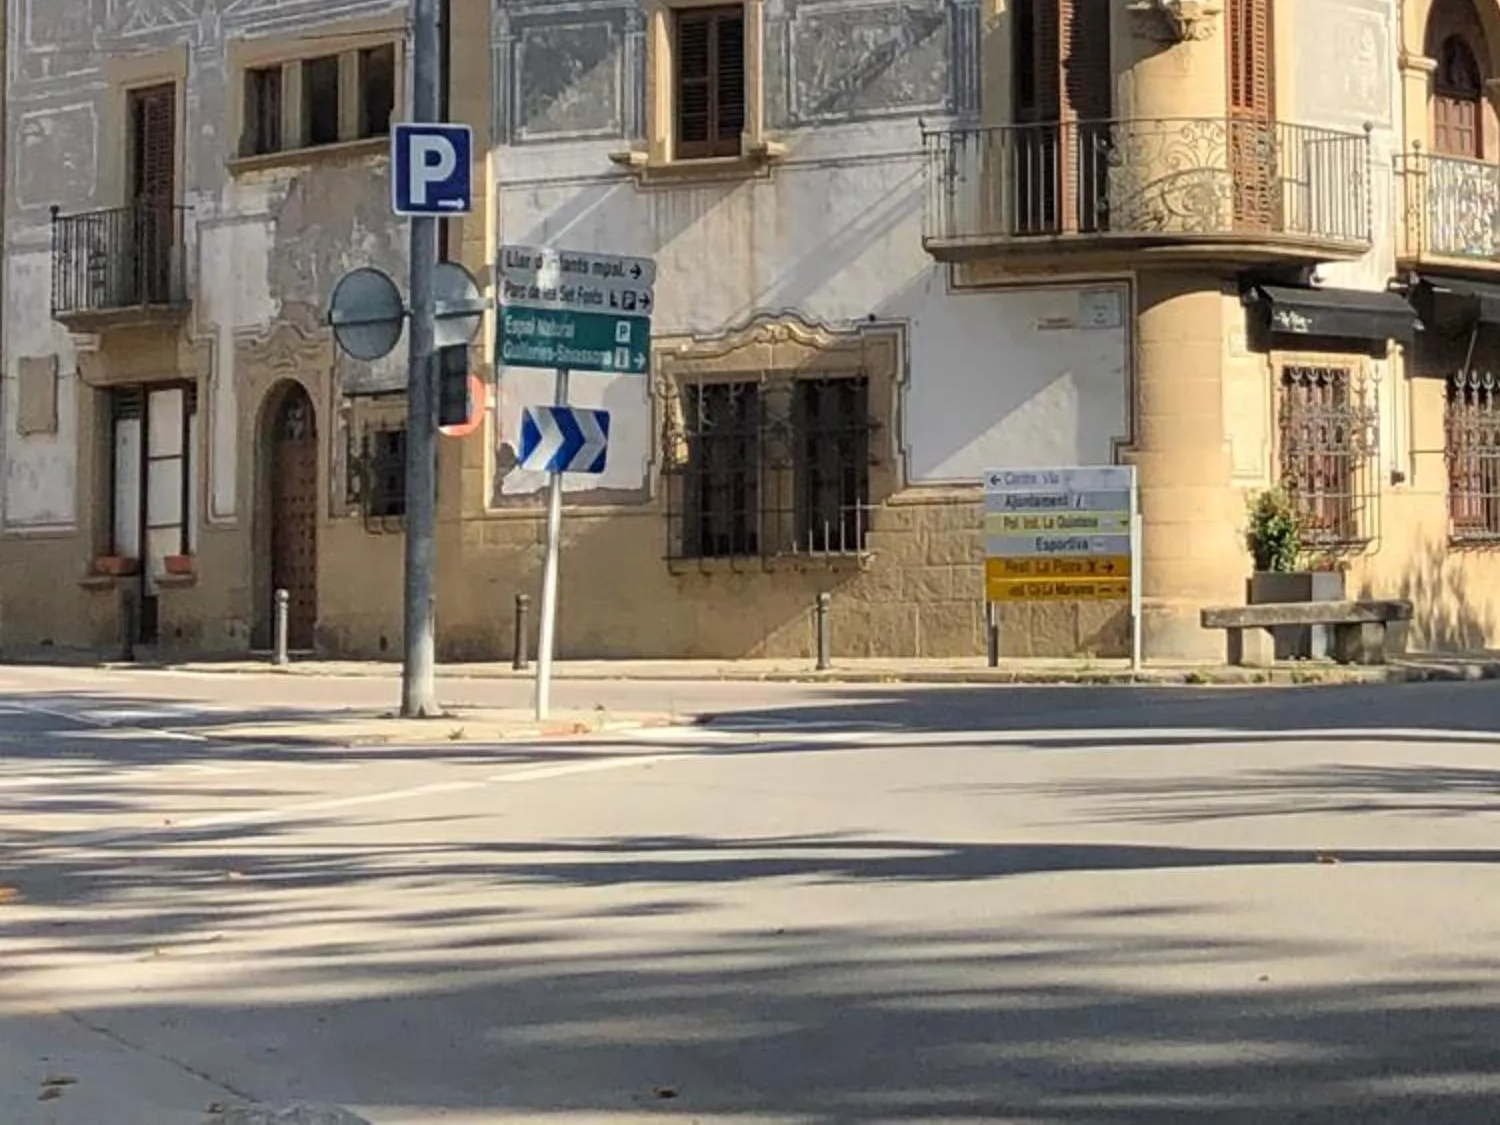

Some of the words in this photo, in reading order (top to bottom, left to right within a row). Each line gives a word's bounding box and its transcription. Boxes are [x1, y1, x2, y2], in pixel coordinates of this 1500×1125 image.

[409, 134, 456, 204] P
[504, 280, 526, 299] Parc
[1005, 494, 1069, 510] Ajuntament
[1035, 536, 1089, 553] Esportiva
